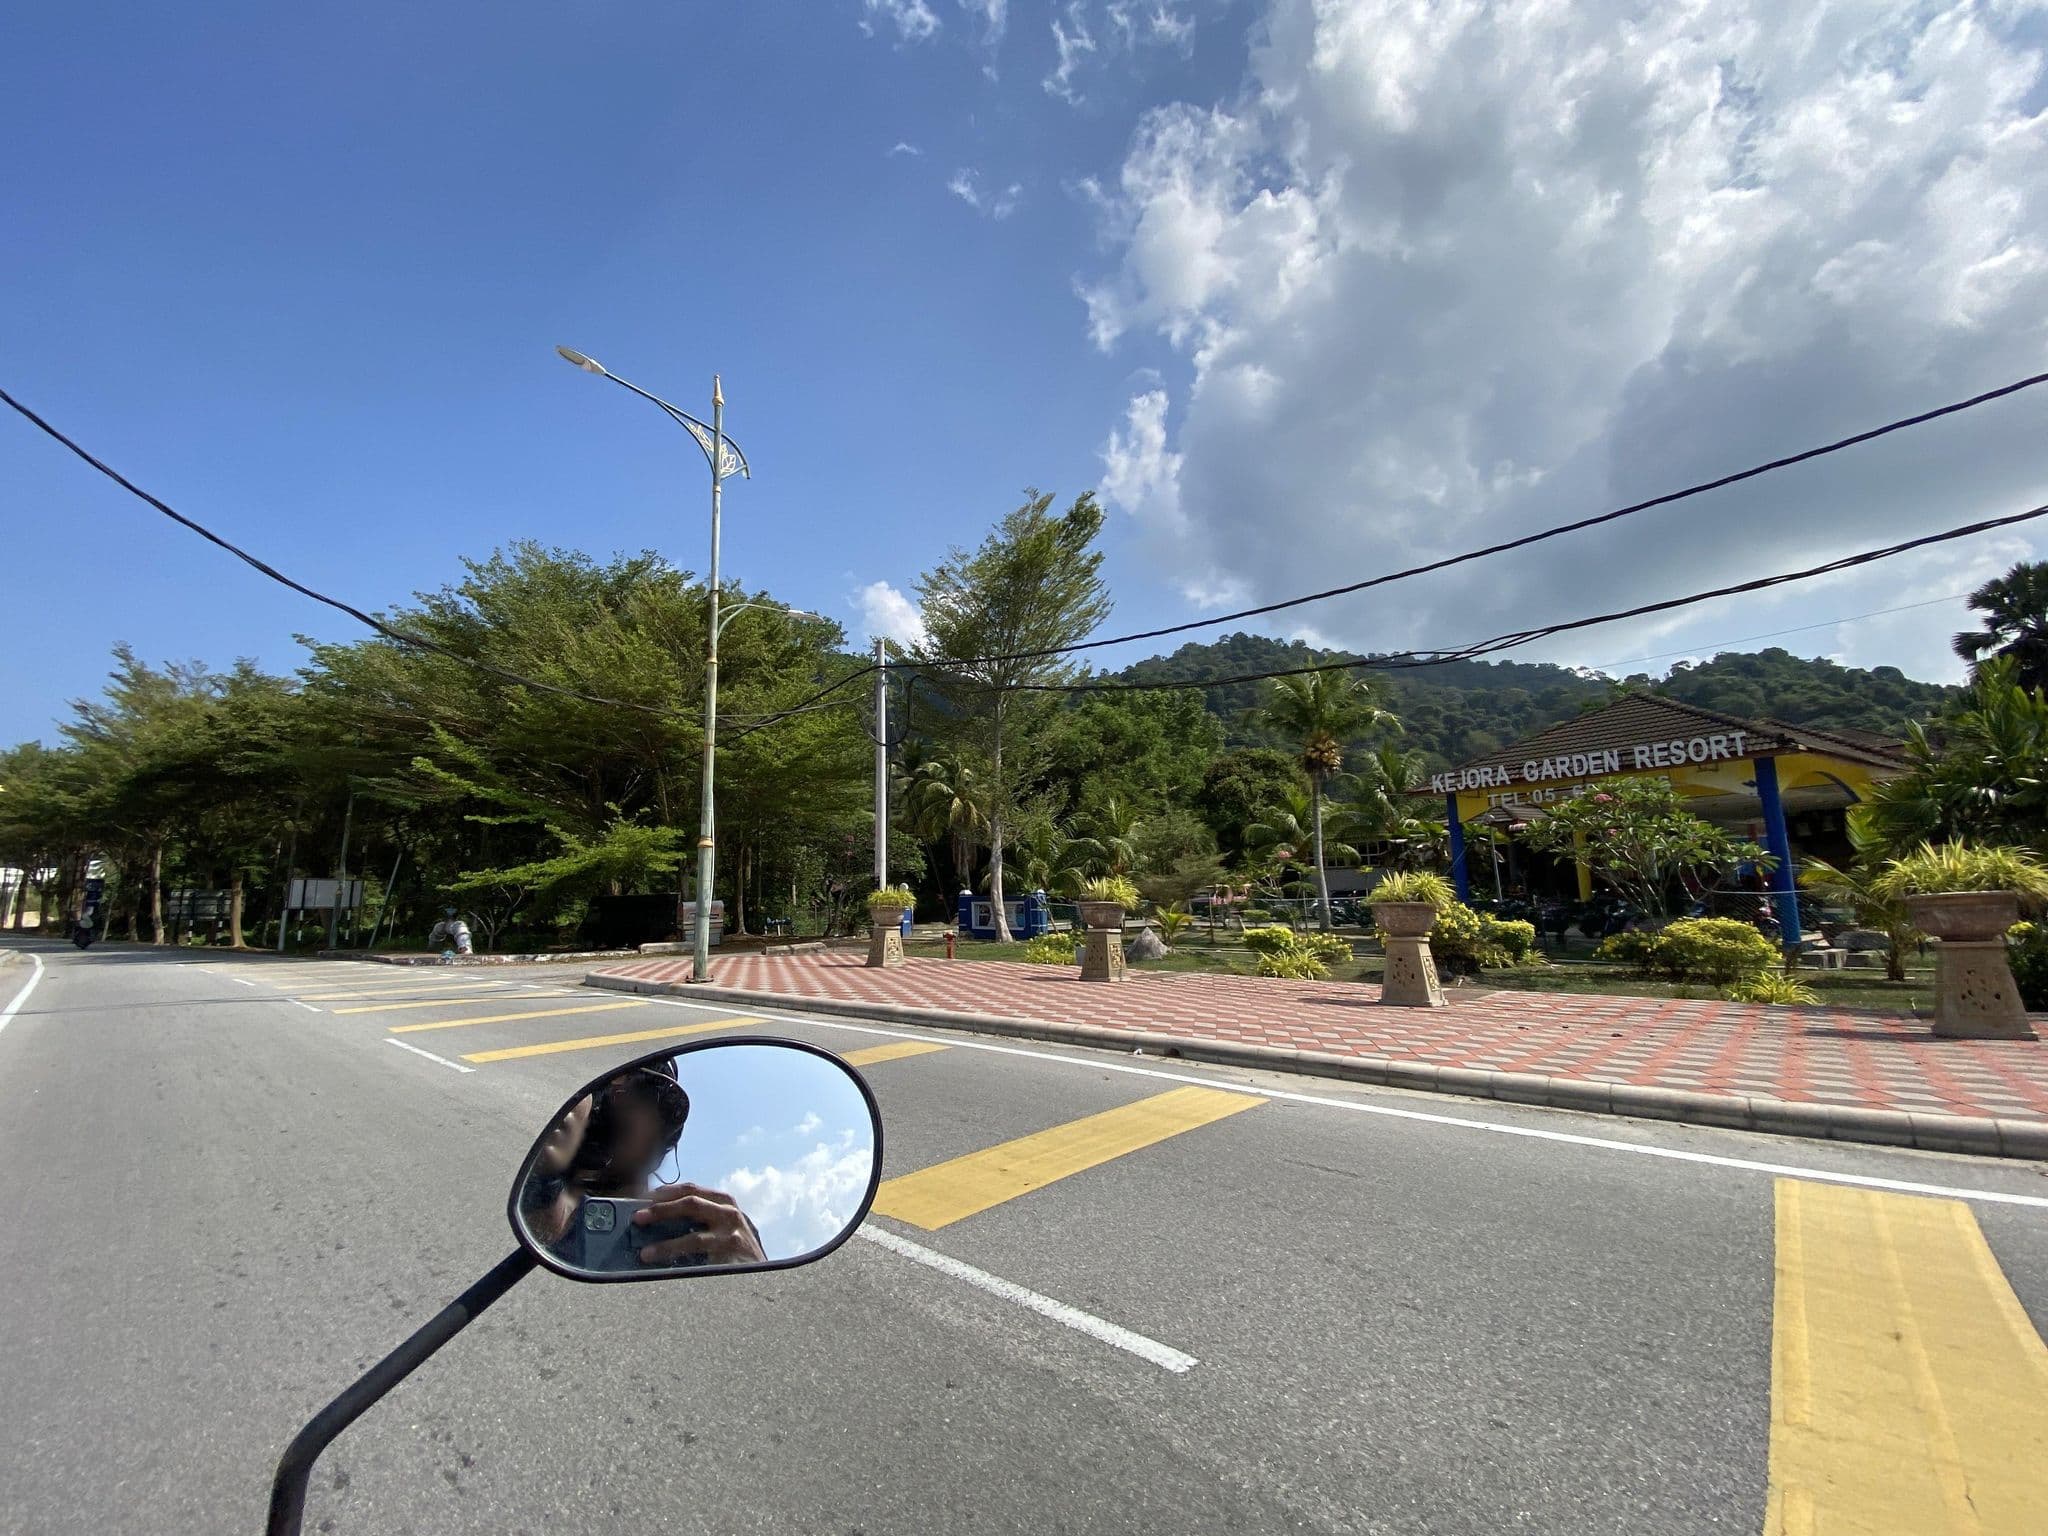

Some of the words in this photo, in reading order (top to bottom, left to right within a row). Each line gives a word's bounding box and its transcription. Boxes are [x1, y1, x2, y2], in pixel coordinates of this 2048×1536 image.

[1431, 765, 1511, 793] KEJORA
[1523, 750, 1619, 782] GARDEN
[1633, 731, 1746, 768] RESORT
